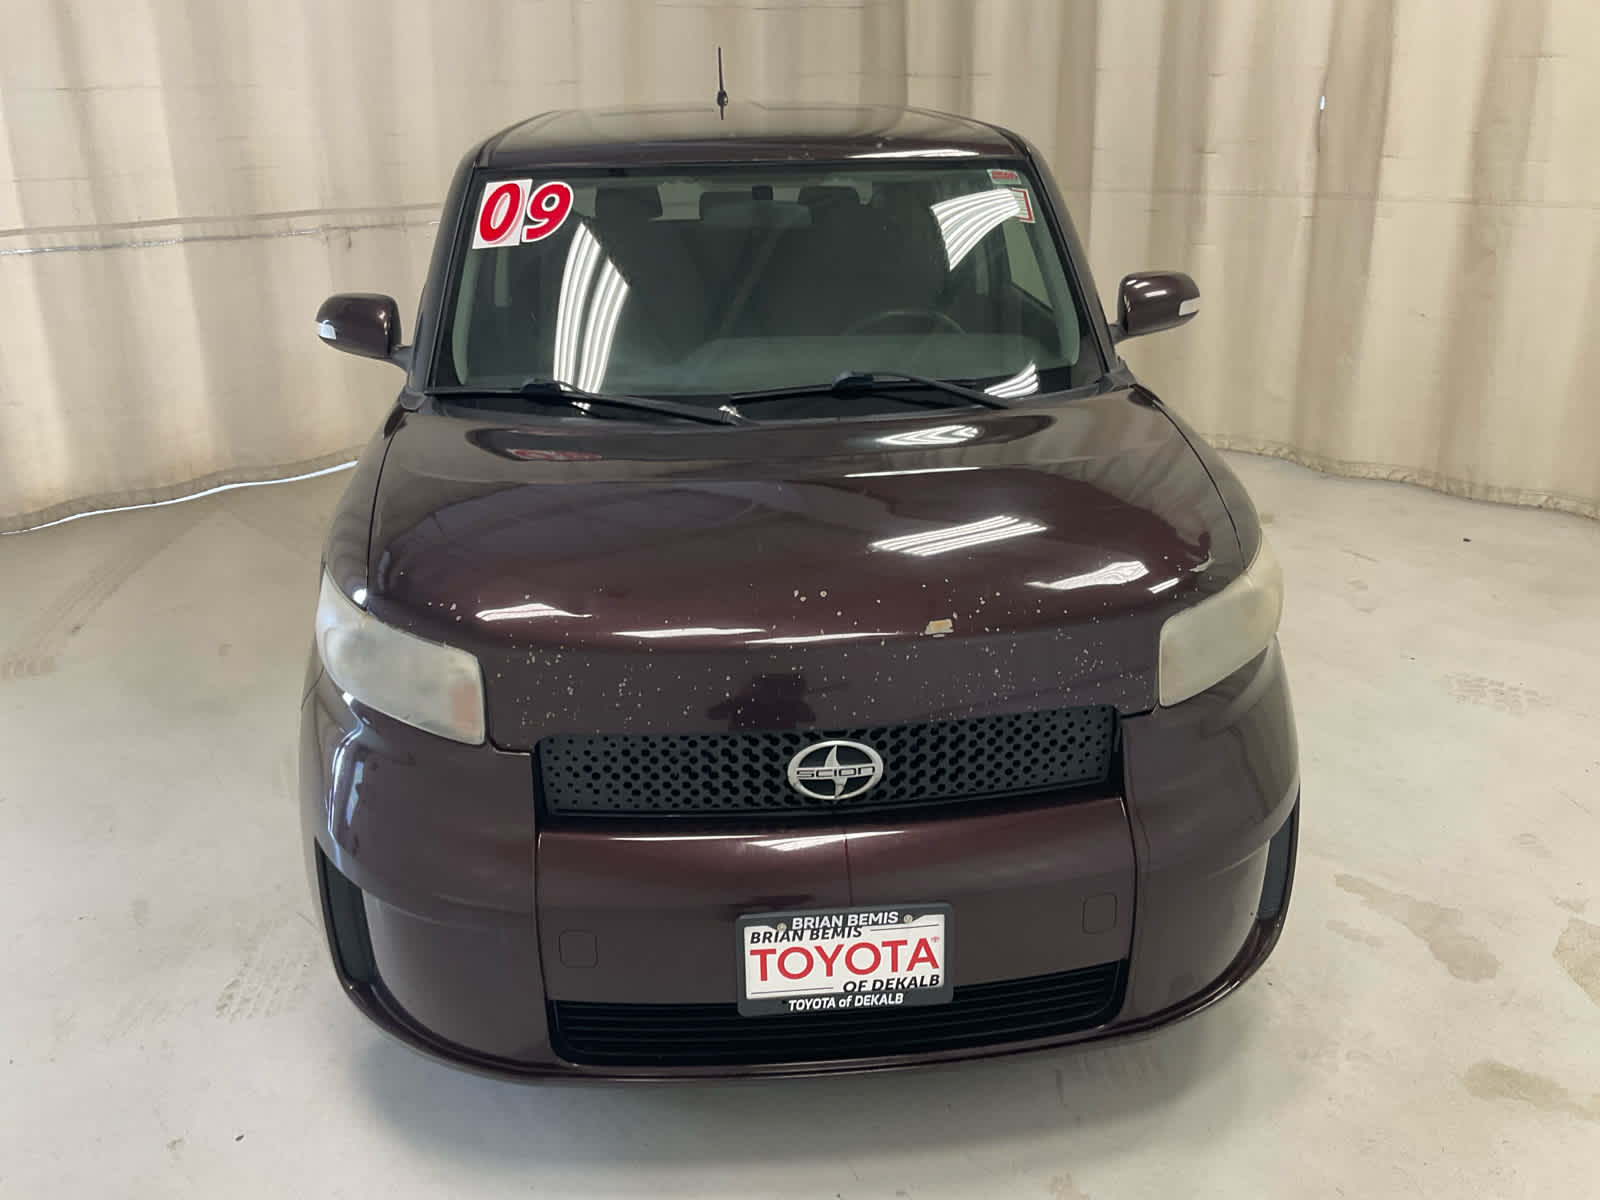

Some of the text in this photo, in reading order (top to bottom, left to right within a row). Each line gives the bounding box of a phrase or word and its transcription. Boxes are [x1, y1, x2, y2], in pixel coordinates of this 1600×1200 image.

[479, 181, 574, 243] 09
[796, 763, 875, 780] SCION
[792, 911, 899, 931] BRIAN BEMIS
[750, 926, 862, 944] BRIAN BEMIS
[749, 937, 940, 982] TOYOTA
[843, 974, 940, 993] OF DEKALB
[789, 992, 904, 1012] TOYOTA of DEKALB
